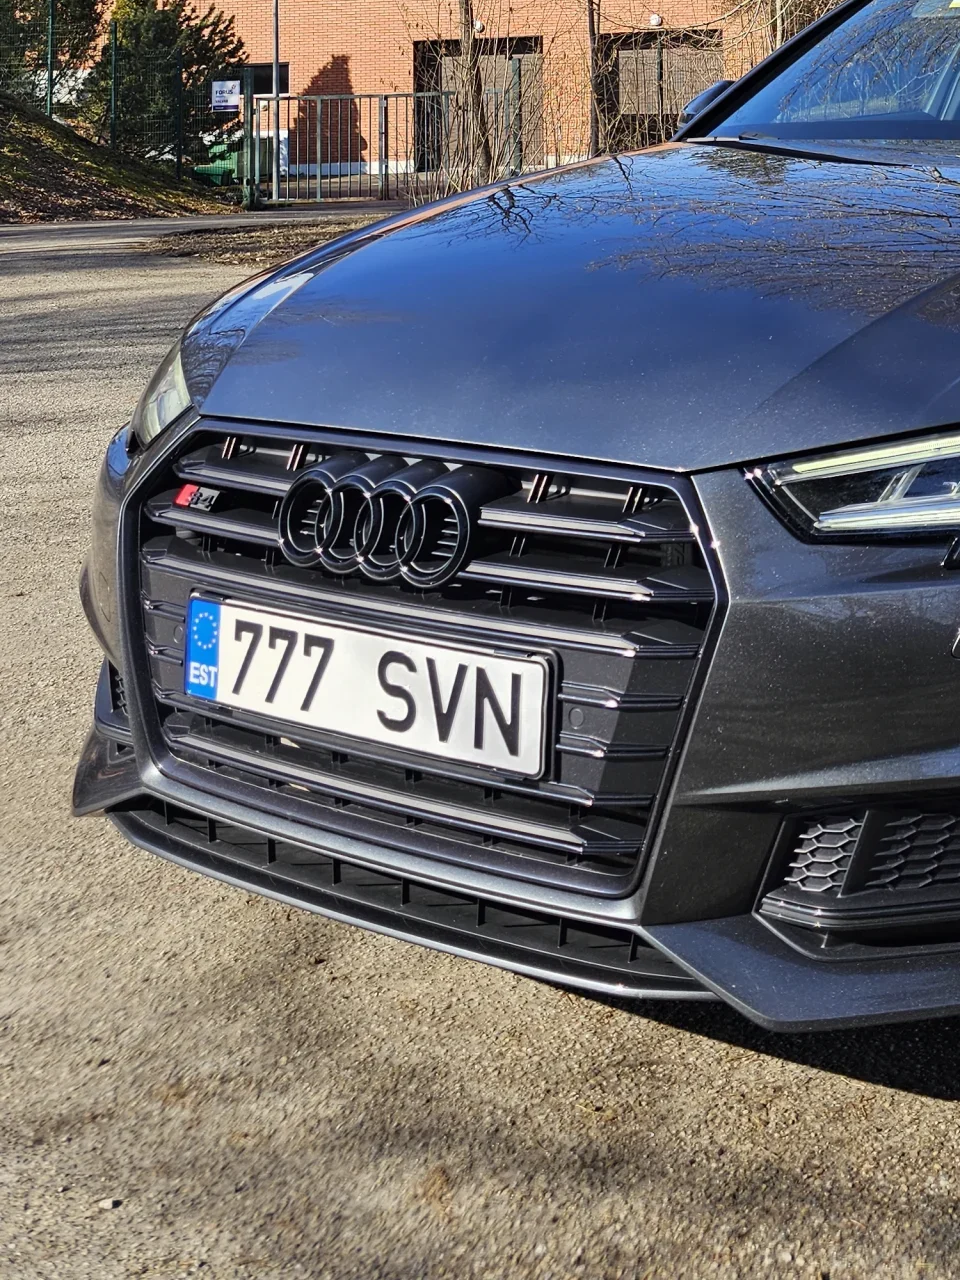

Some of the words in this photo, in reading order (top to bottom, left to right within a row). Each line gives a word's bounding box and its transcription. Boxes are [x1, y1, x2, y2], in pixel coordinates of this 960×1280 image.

[187, 490, 216, 510] S4
[189, 661, 218, 688] EST
[231, 618, 335, 712] 777
[376, 650, 522, 758] SVN
